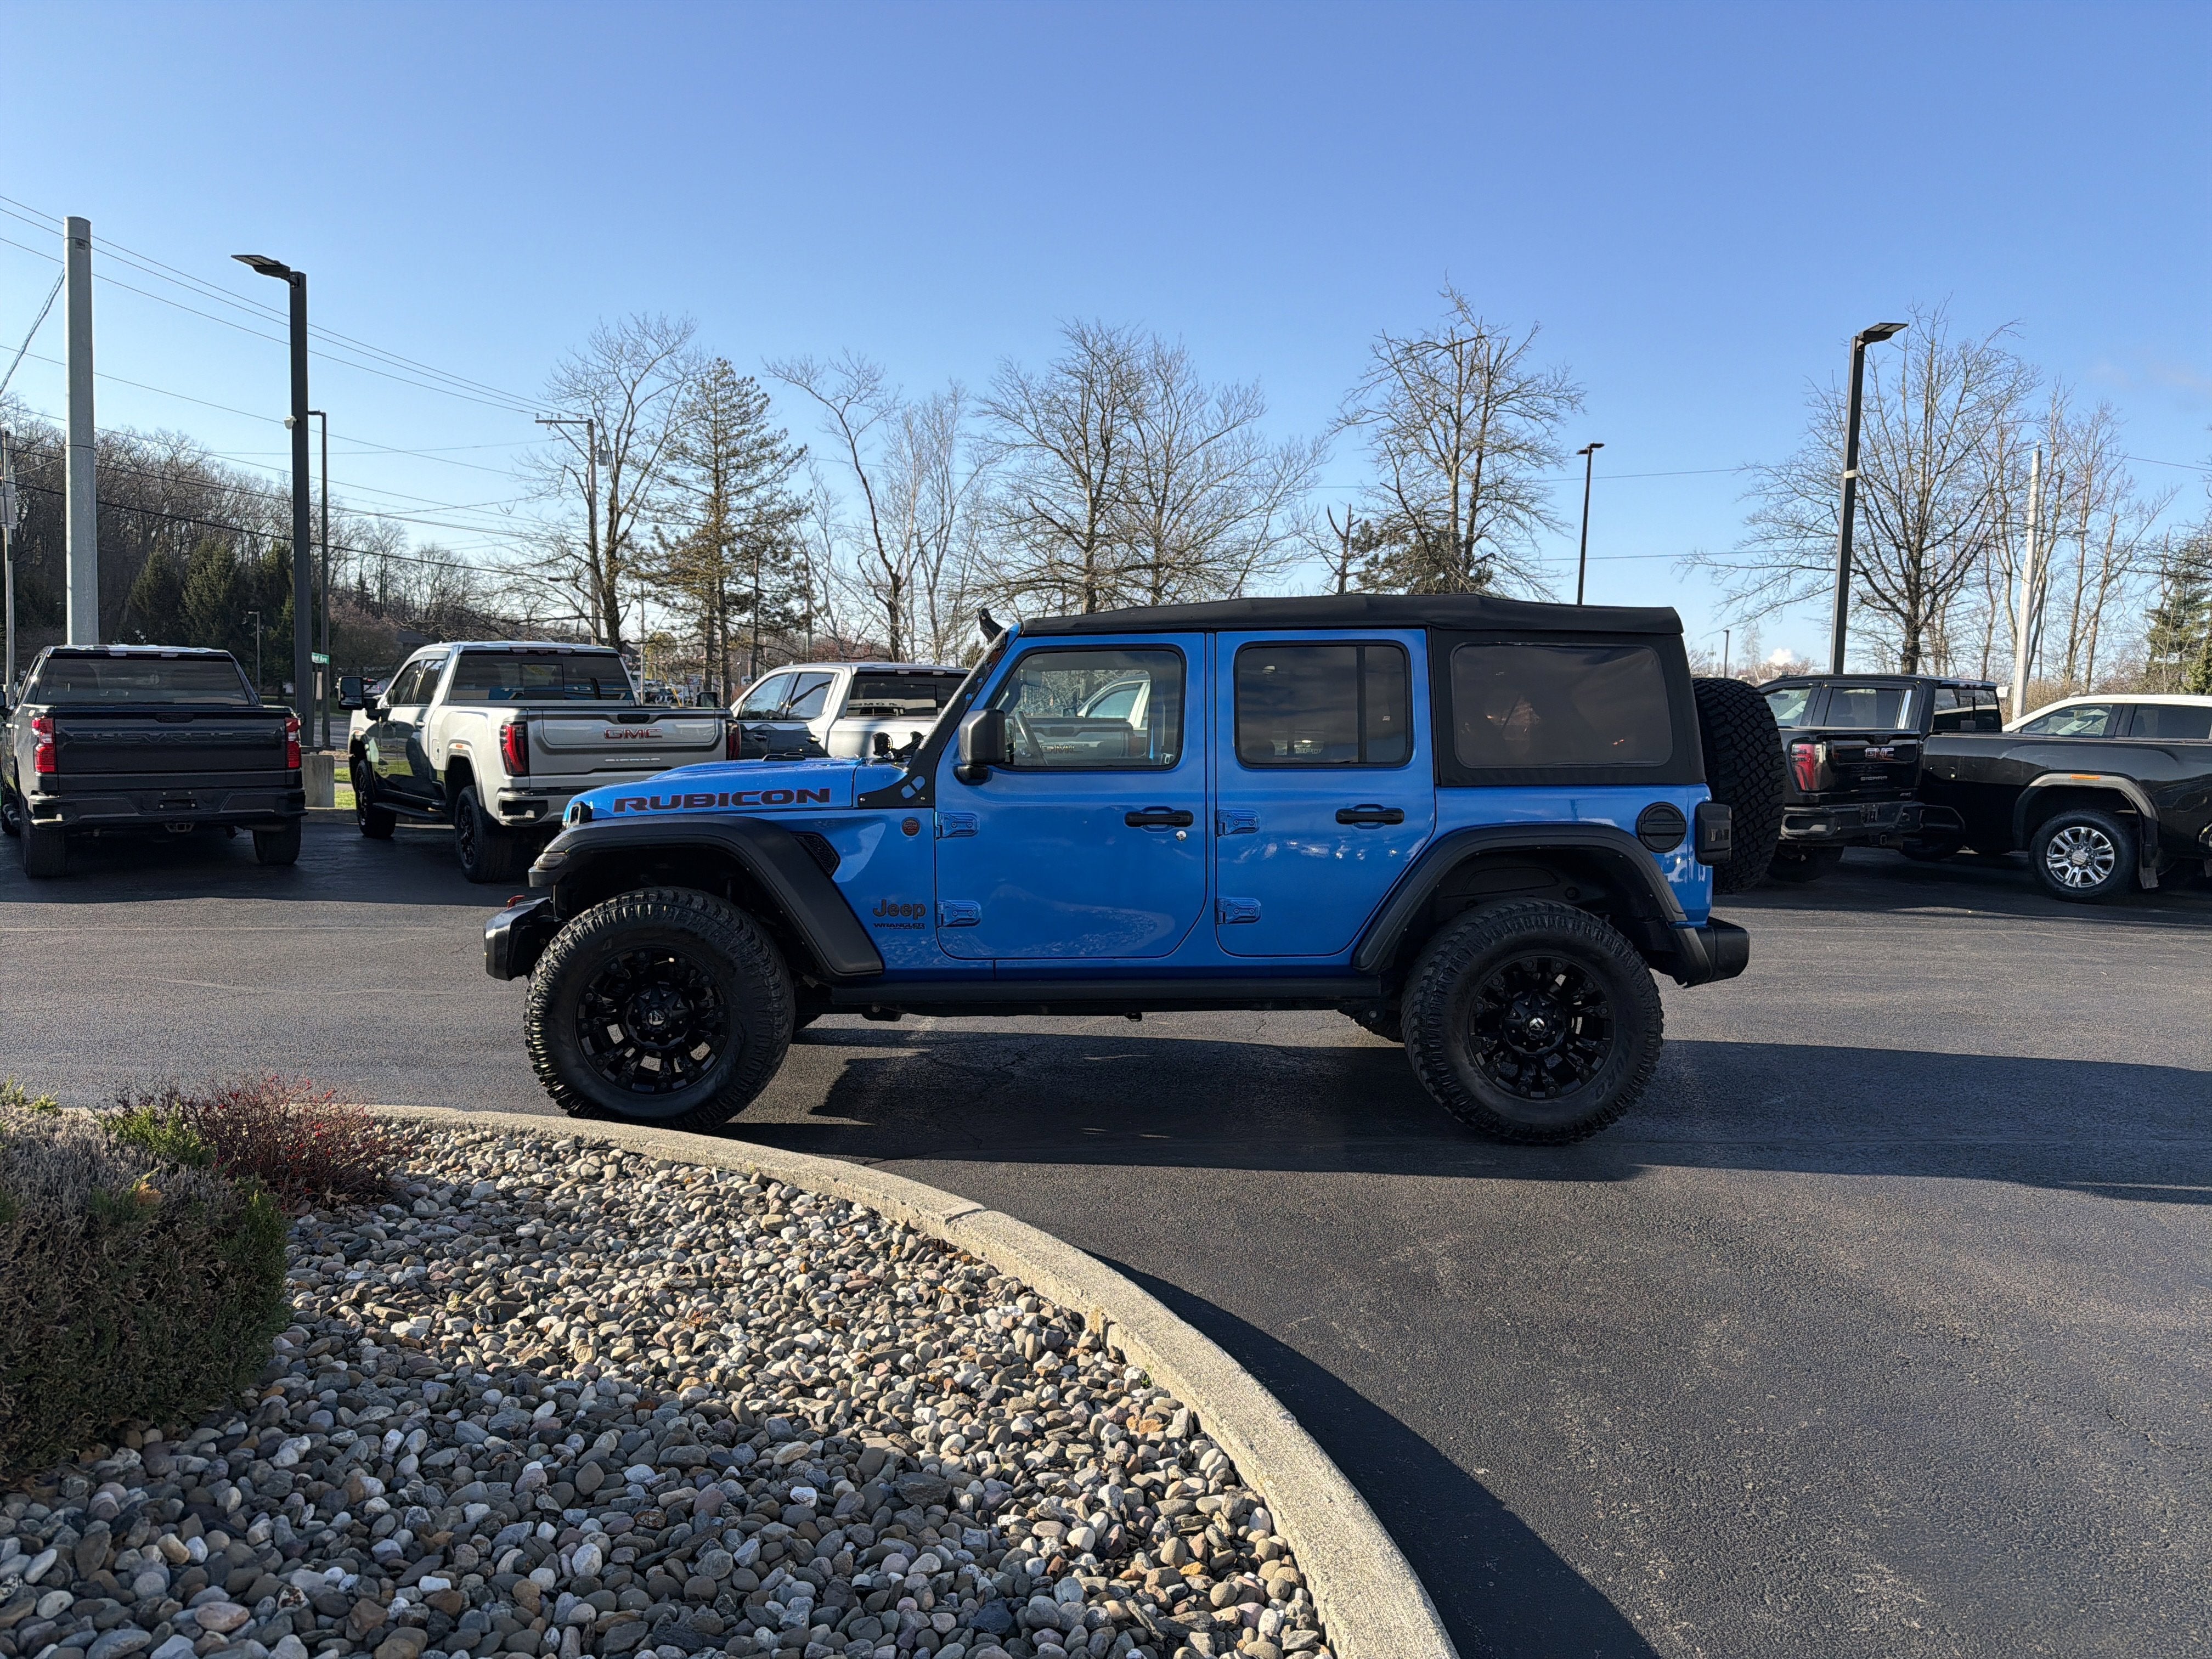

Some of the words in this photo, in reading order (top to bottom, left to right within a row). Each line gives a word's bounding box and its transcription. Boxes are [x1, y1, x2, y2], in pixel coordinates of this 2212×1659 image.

[605, 728, 663, 739] GMC
[1041, 743, 1085, 754] GMC
[1865, 747, 1895, 758] GMC
[613, 788, 830, 813] RUBICON
[873, 899, 926, 919] Jeep
